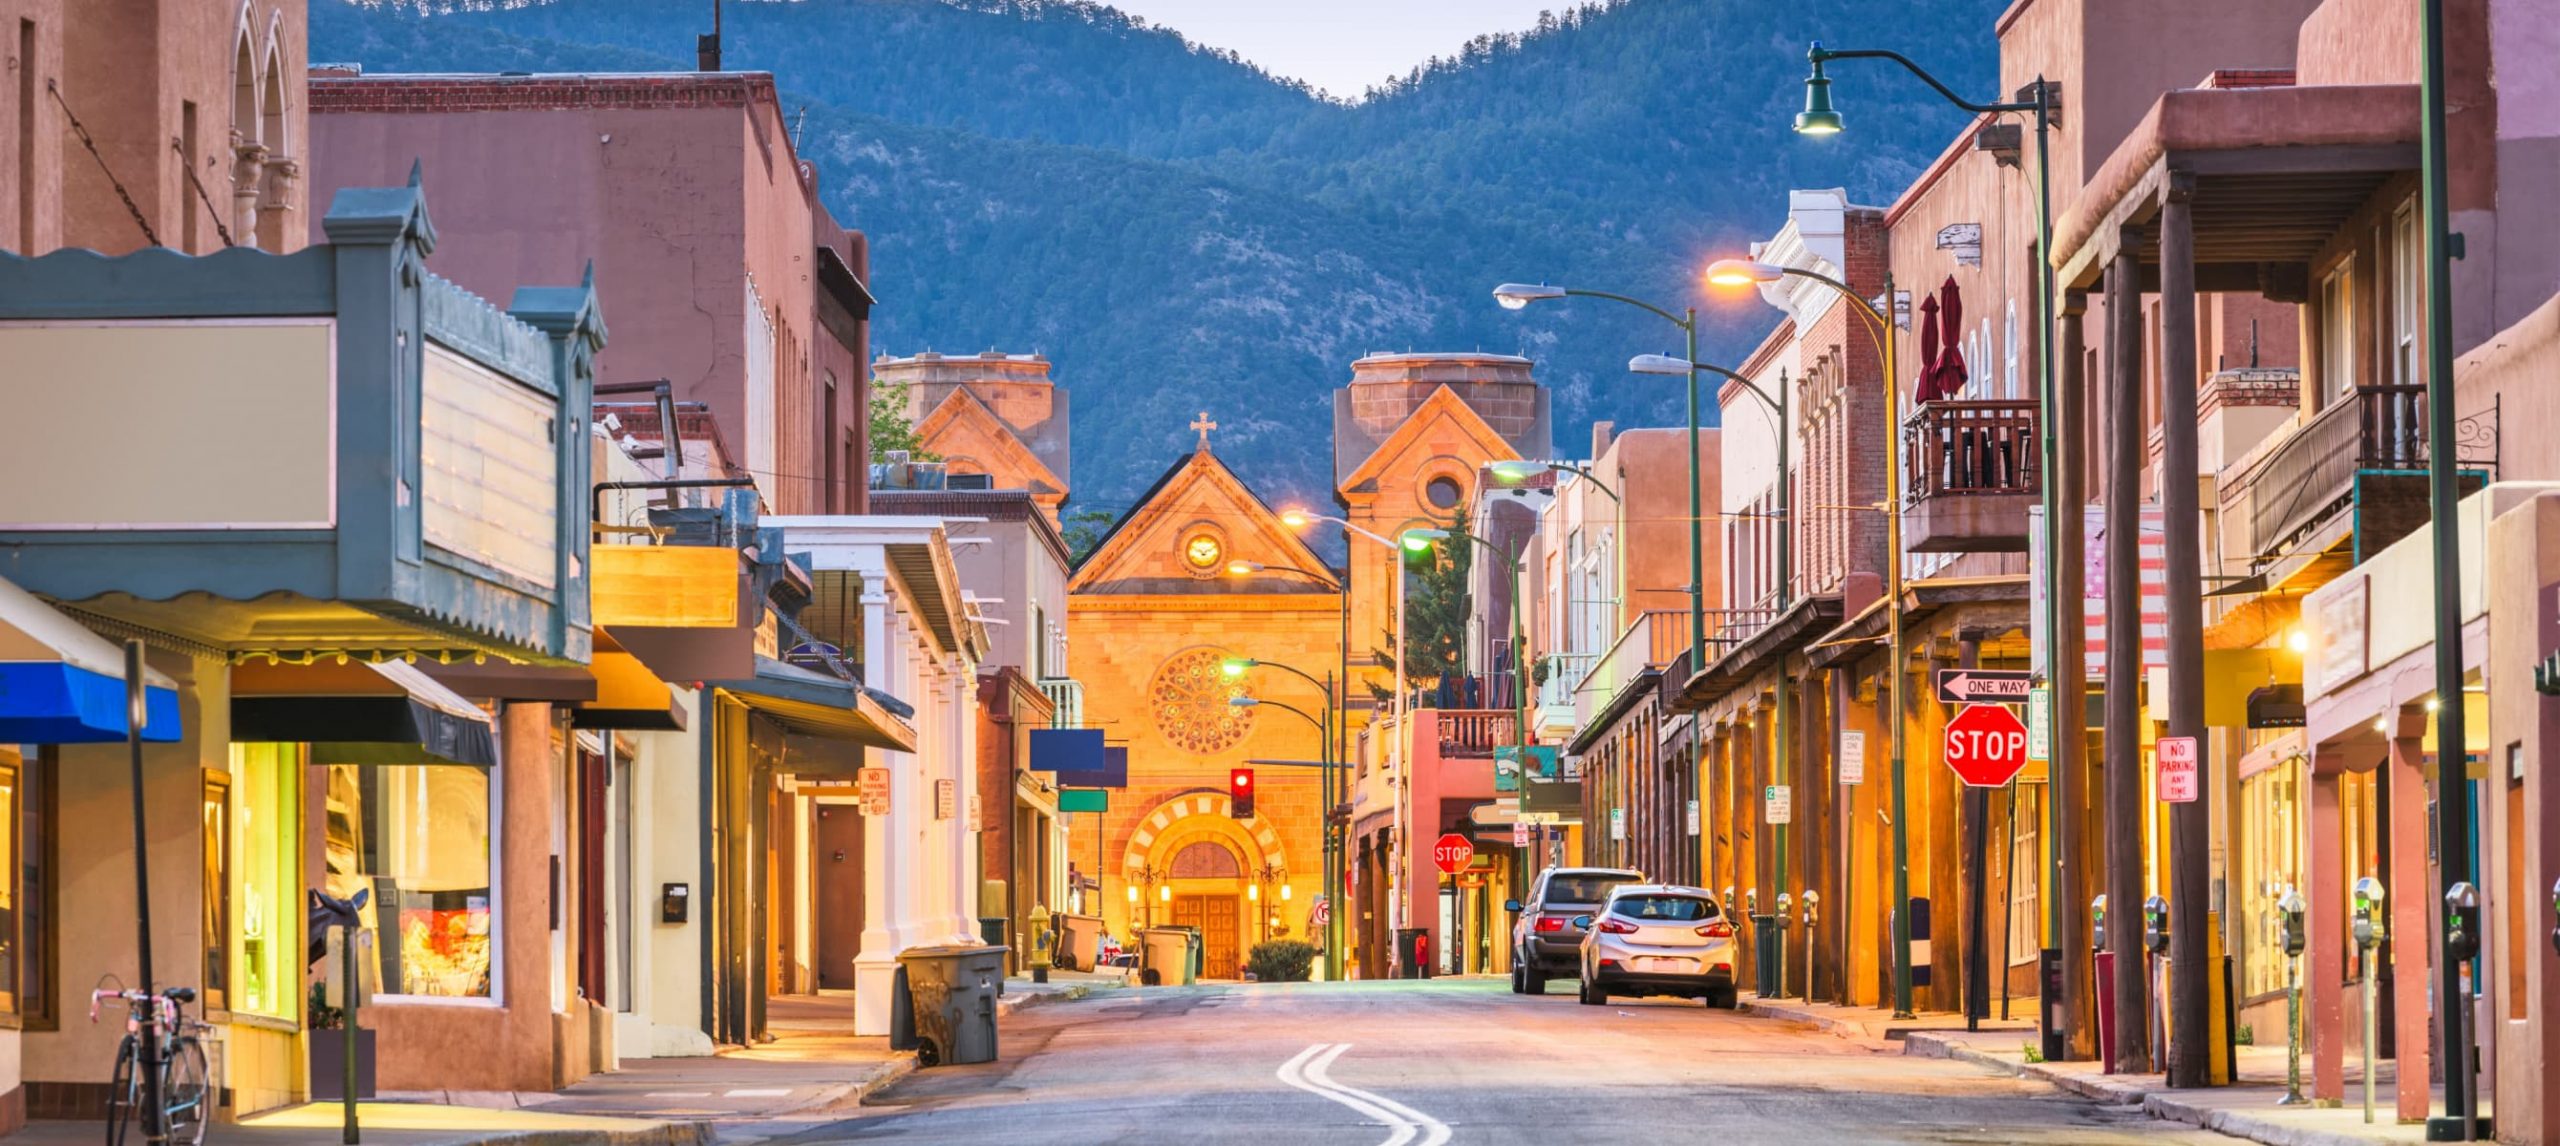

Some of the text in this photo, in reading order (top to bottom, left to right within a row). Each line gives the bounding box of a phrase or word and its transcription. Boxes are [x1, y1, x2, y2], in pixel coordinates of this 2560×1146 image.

[1968, 681, 2026, 693] ONE WAY
[1948, 730, 2025, 761] STOP
[2171, 744, 2185, 756] NO
[2160, 760, 2194, 772] PARKING
[868, 772, 880, 781] NO
[2171, 775, 2185, 784] ANY
[1768, 788, 1774, 799] 2
[2171, 786, 2187, 795] TIME
[1435, 847, 1471, 862] STOP
